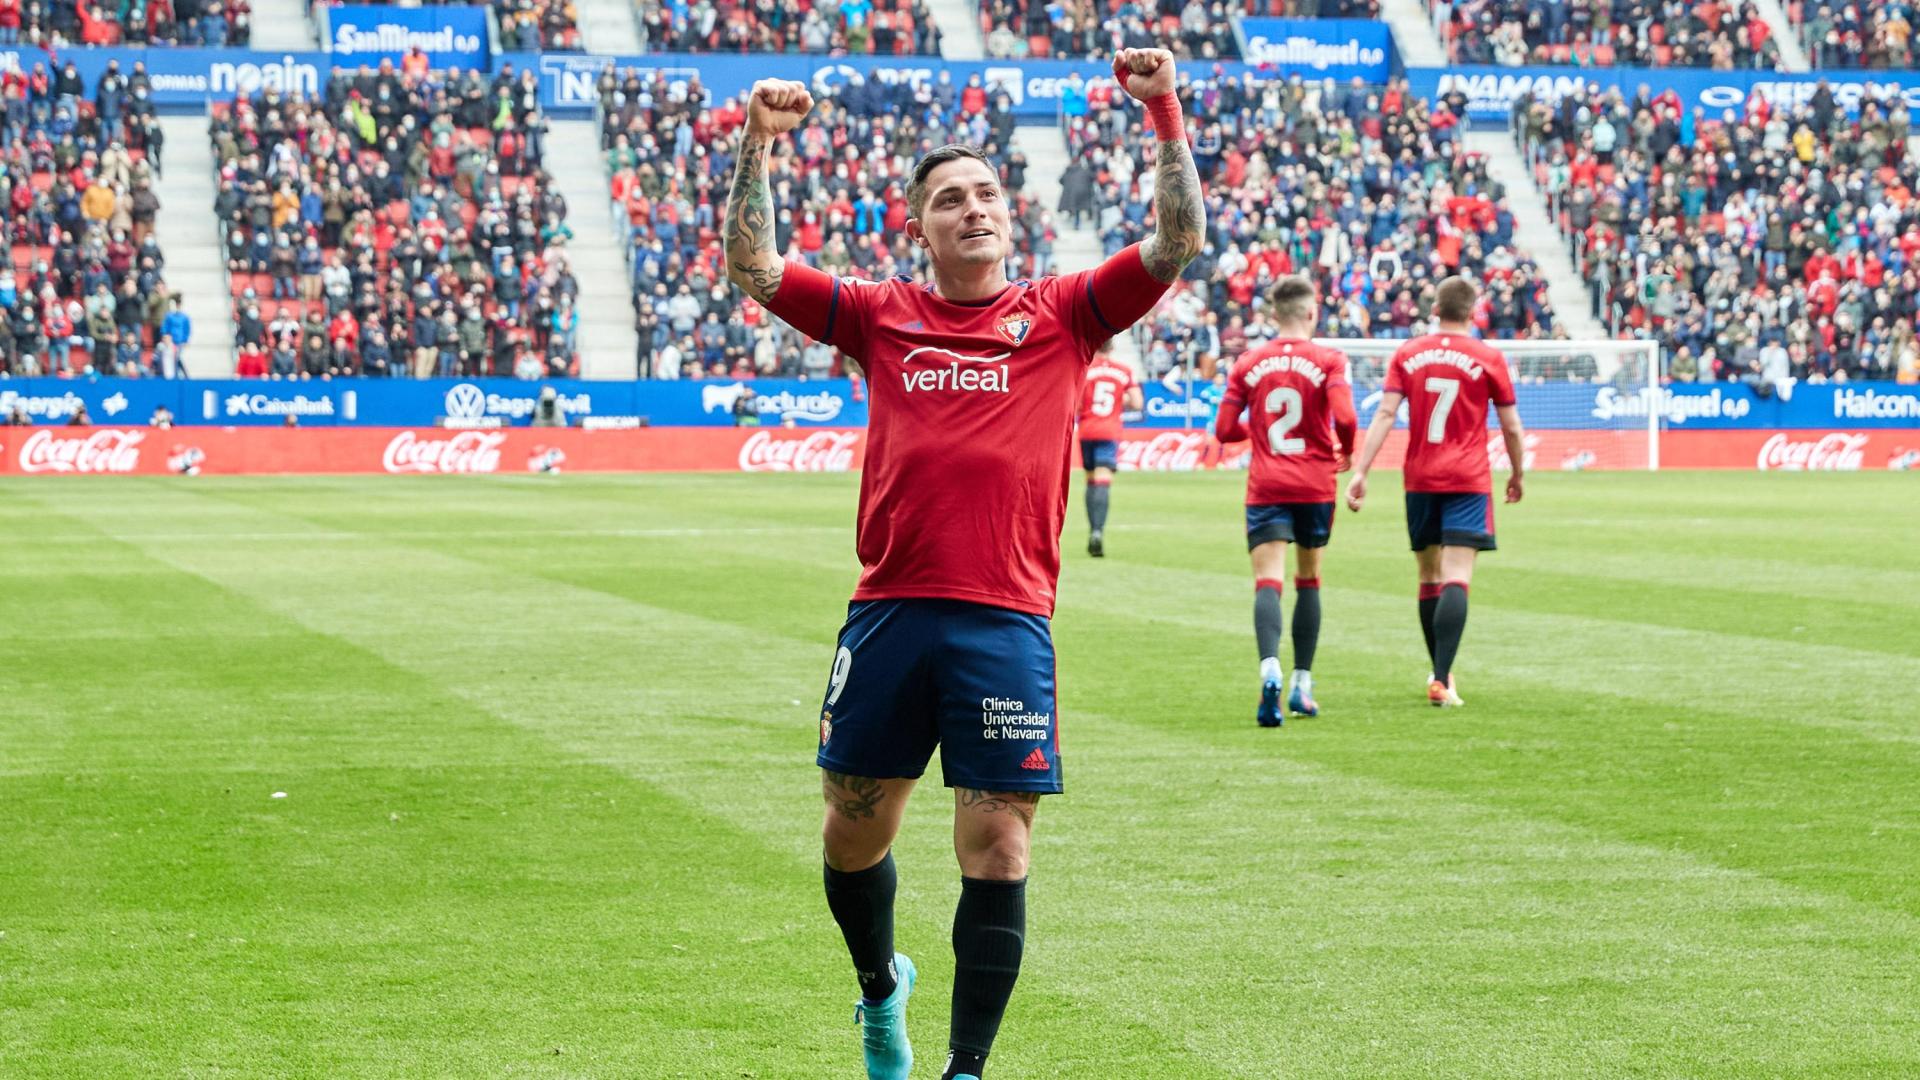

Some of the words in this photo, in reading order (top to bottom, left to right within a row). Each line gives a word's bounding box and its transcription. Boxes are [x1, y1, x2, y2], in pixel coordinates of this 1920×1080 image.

[902, 362, 1010, 392] verleal
[1243, 355, 1290, 388] NACHO
[1291, 355, 1327, 389] VIDAL
[1402, 348, 1484, 382] MONCAYOLA
[1090, 381, 1116, 417] 5
[1425, 377, 1460, 444] 7
[1265, 387, 1306, 456] 2
[827, 646, 852, 706] 9
[982, 697, 1023, 711] Clínica
[983, 712, 1049, 726] Universidad
[983, 726, 999, 739] de
[1002, 726, 1047, 740] Navarra
